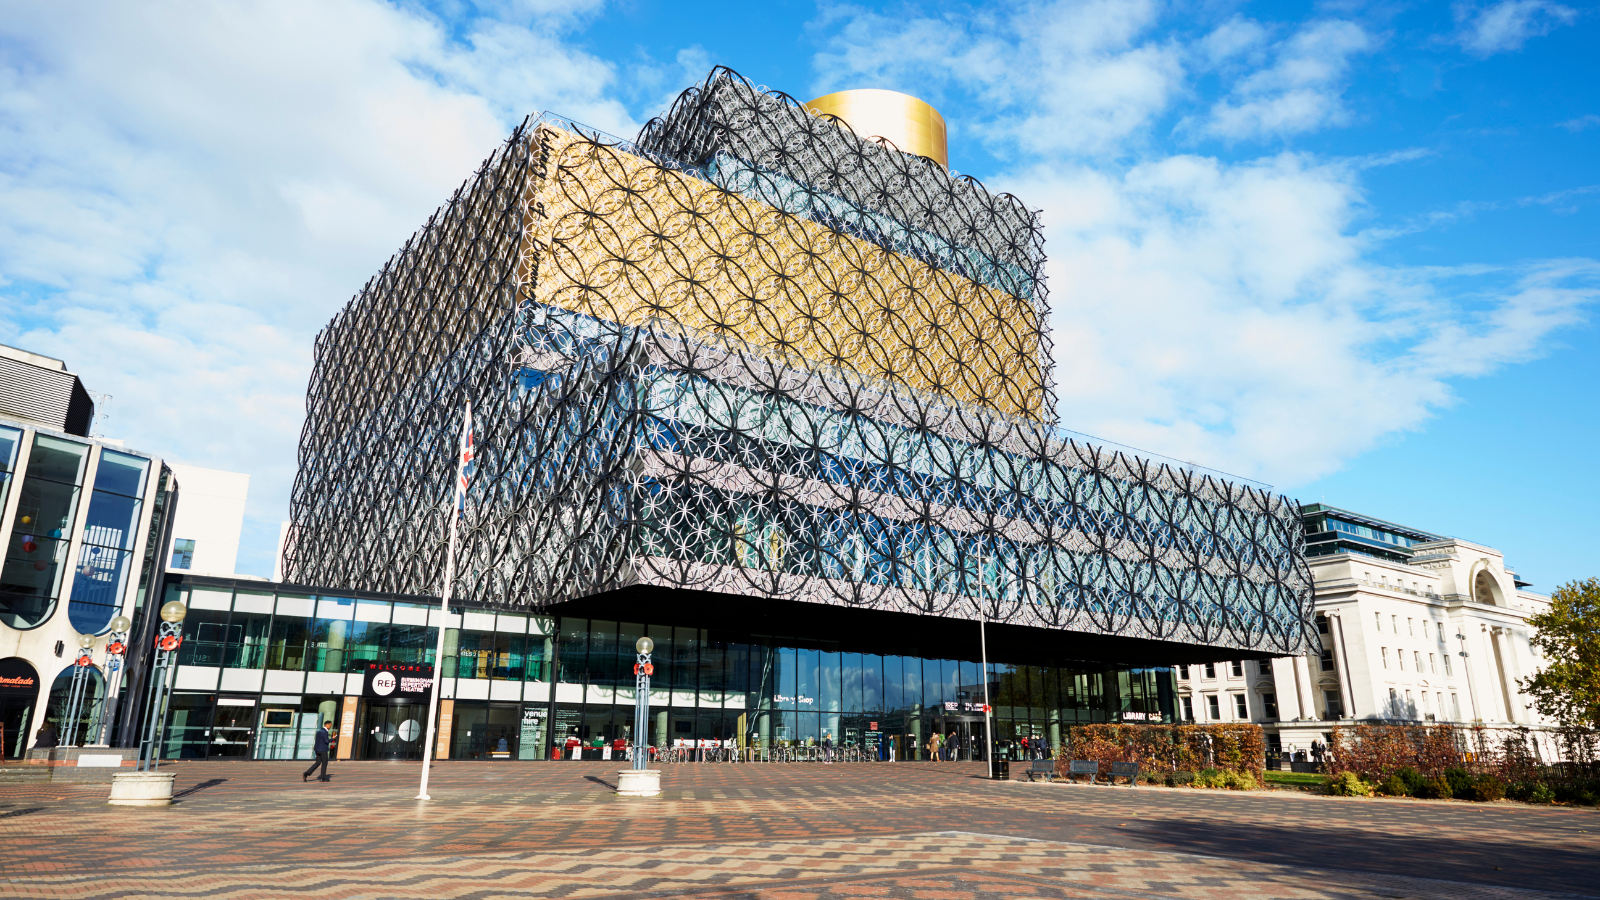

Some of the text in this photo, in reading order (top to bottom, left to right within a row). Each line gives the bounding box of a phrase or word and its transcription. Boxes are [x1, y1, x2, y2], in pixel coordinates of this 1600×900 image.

[531, 128, 559, 180] Library
[528, 201, 549, 223] of
[370, 664, 420, 672] WELCOME
[377, 680, 396, 688] REP
[774, 695, 813, 705] Library Shop
[523, 716, 539, 724] hire
[1123, 711, 1146, 720] LIBRARY
